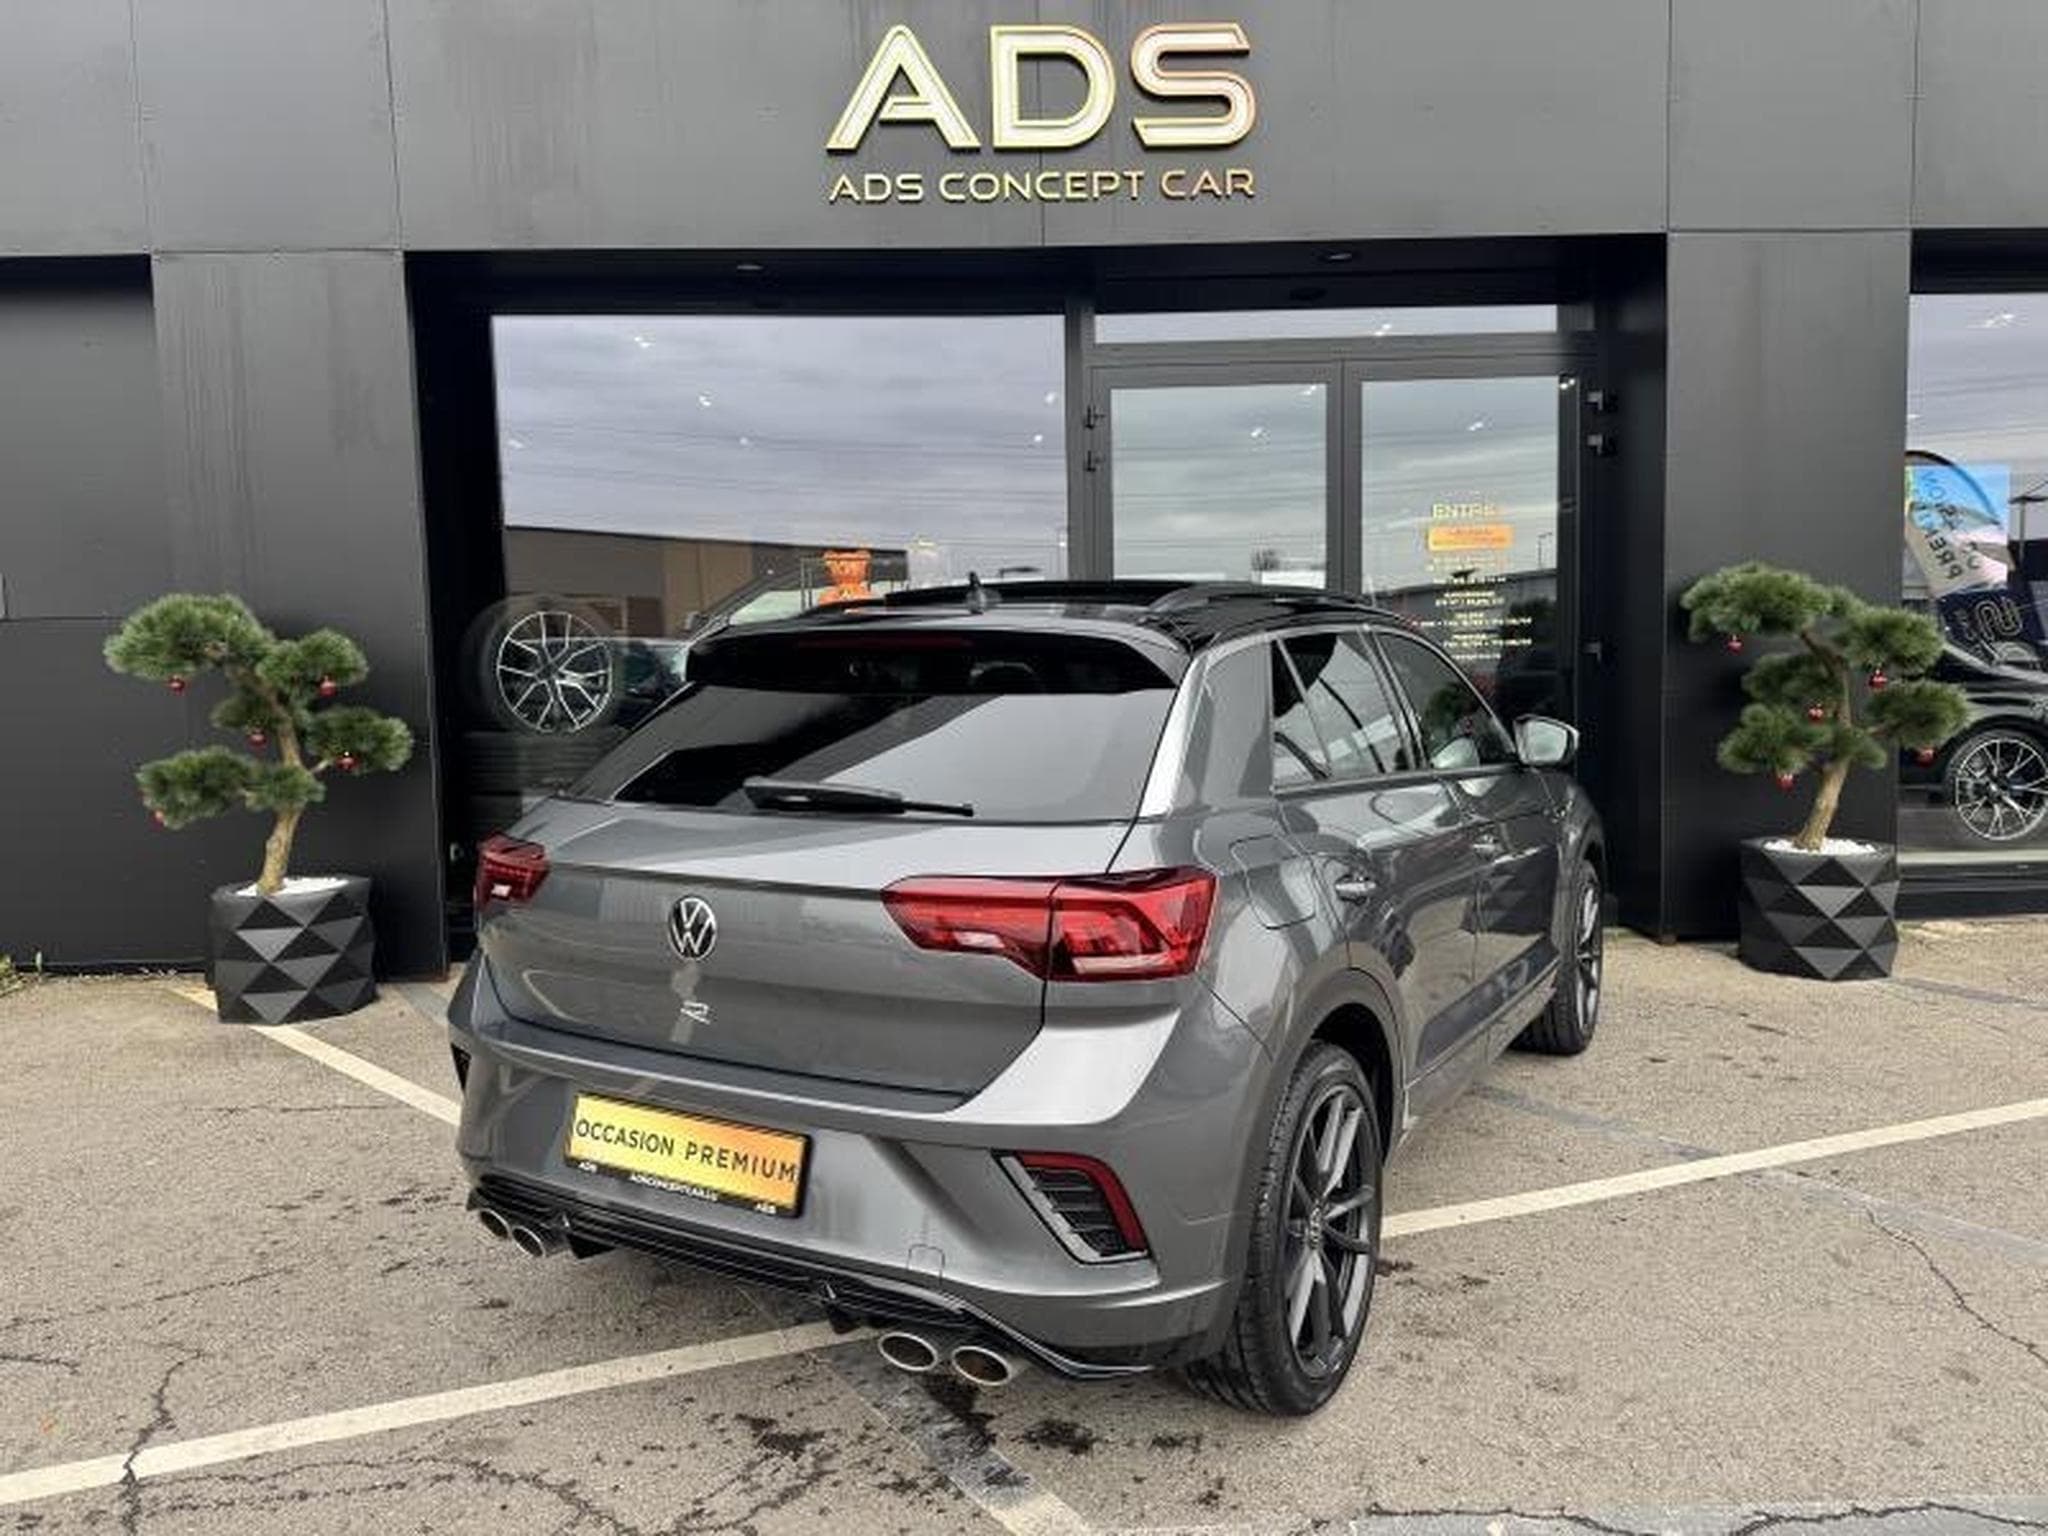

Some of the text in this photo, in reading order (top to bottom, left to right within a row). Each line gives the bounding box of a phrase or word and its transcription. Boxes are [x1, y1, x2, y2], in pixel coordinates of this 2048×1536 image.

[826, 22, 1256, 151] ADS
[828, 169, 1256, 202] ADS CONCEPT CAR
[575, 1119, 796, 1181] OCCASION PREMIUM
